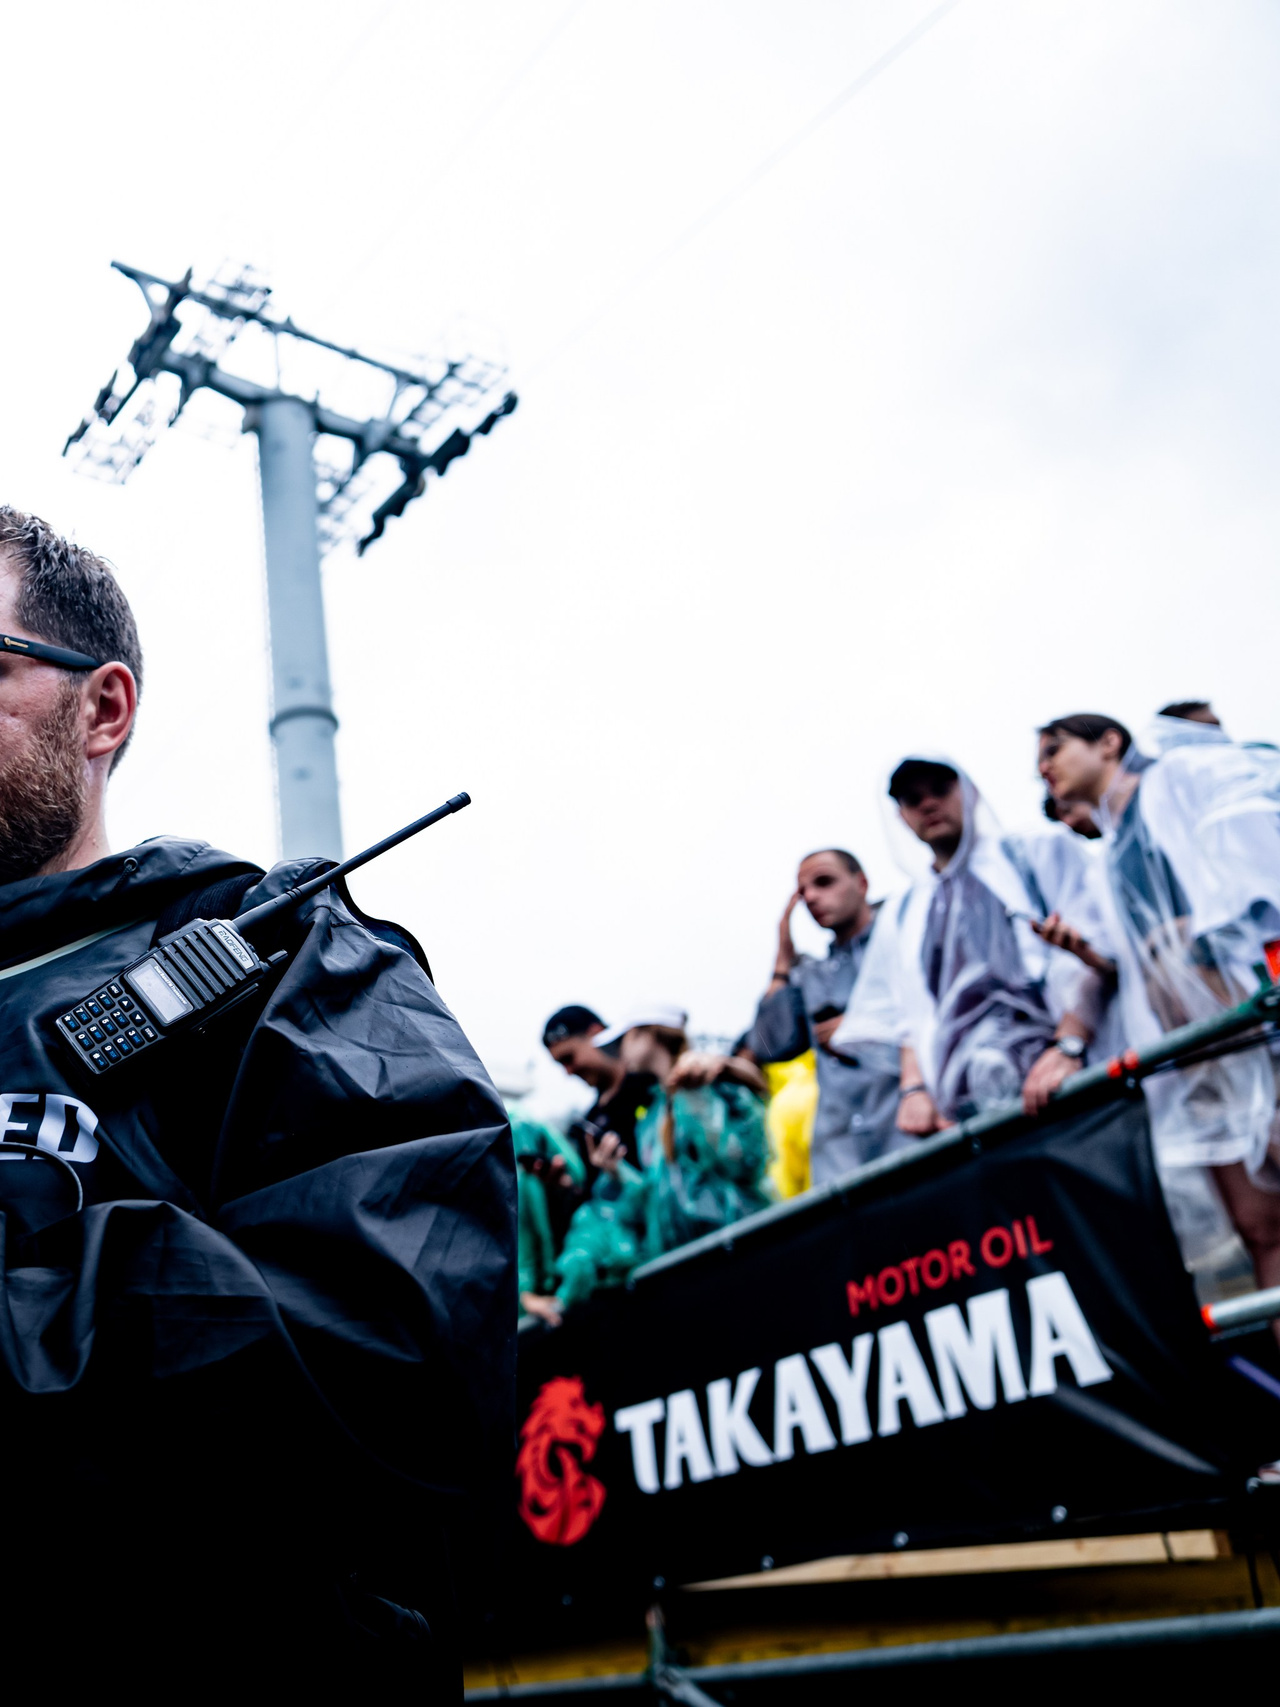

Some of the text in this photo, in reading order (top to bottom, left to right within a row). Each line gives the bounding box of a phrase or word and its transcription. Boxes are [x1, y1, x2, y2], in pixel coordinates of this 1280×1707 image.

[219, 930, 249, 962] BAOFENG
[846, 1214, 1054, 1317] MOTOR OIL
[614, 1270, 1113, 1495] TAKAYAMA
